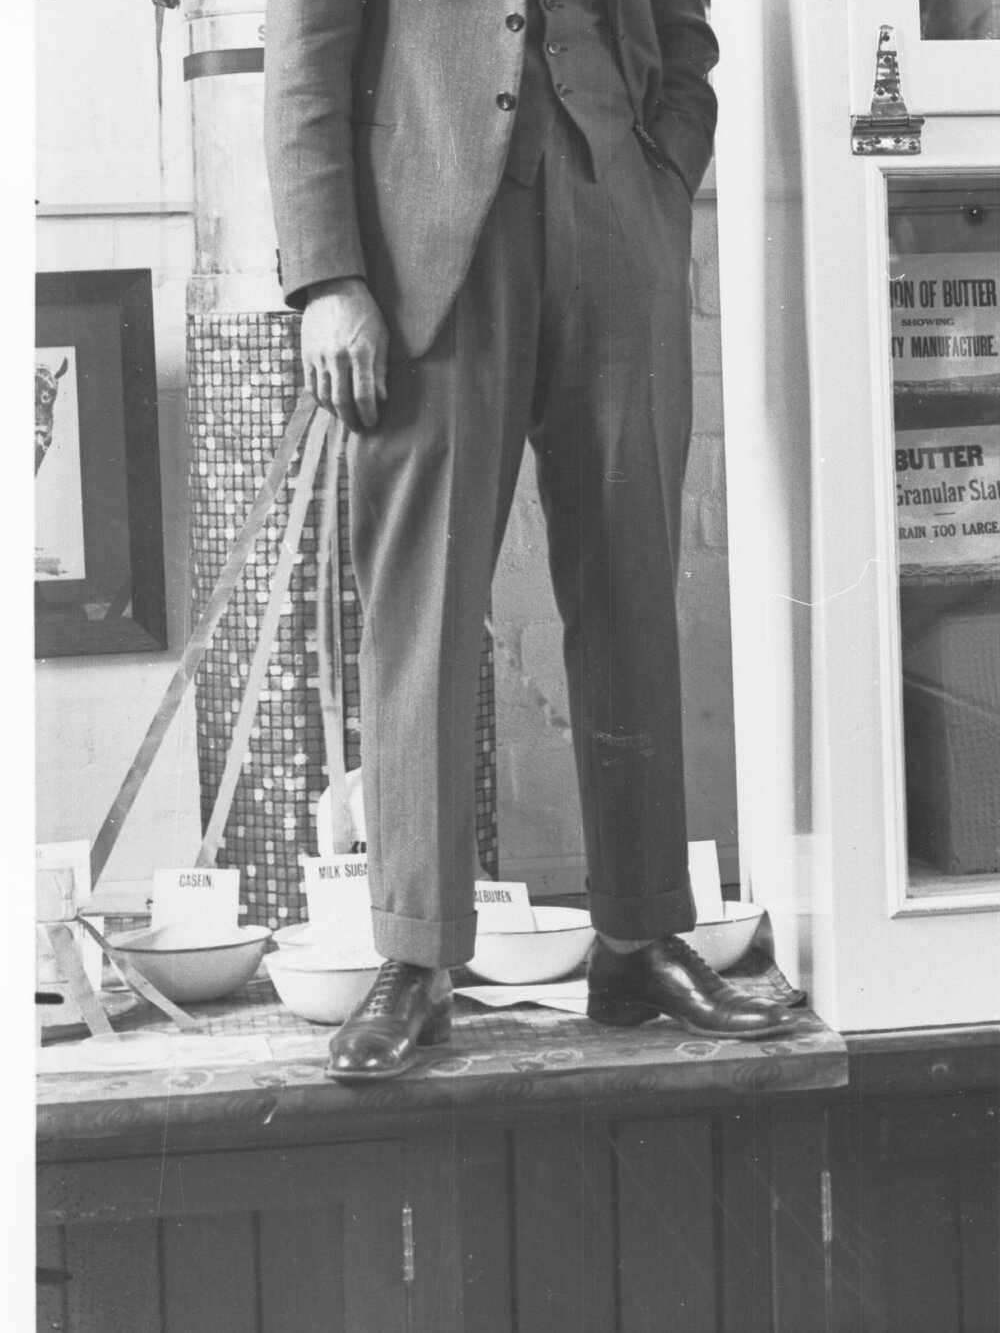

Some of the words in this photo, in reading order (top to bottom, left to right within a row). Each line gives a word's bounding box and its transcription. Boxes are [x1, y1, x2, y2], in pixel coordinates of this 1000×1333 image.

[920, 280, 937, 308] OF
[943, 279, 997, 307] BUTTER
[901, 318, 955, 326] SHOWING
[910, 335, 999, 358] MANUFACTURE.
[895, 445, 984, 472] BUTTER
[931, 524, 956, 537] TOO
[318, 865, 340, 880] MILK
